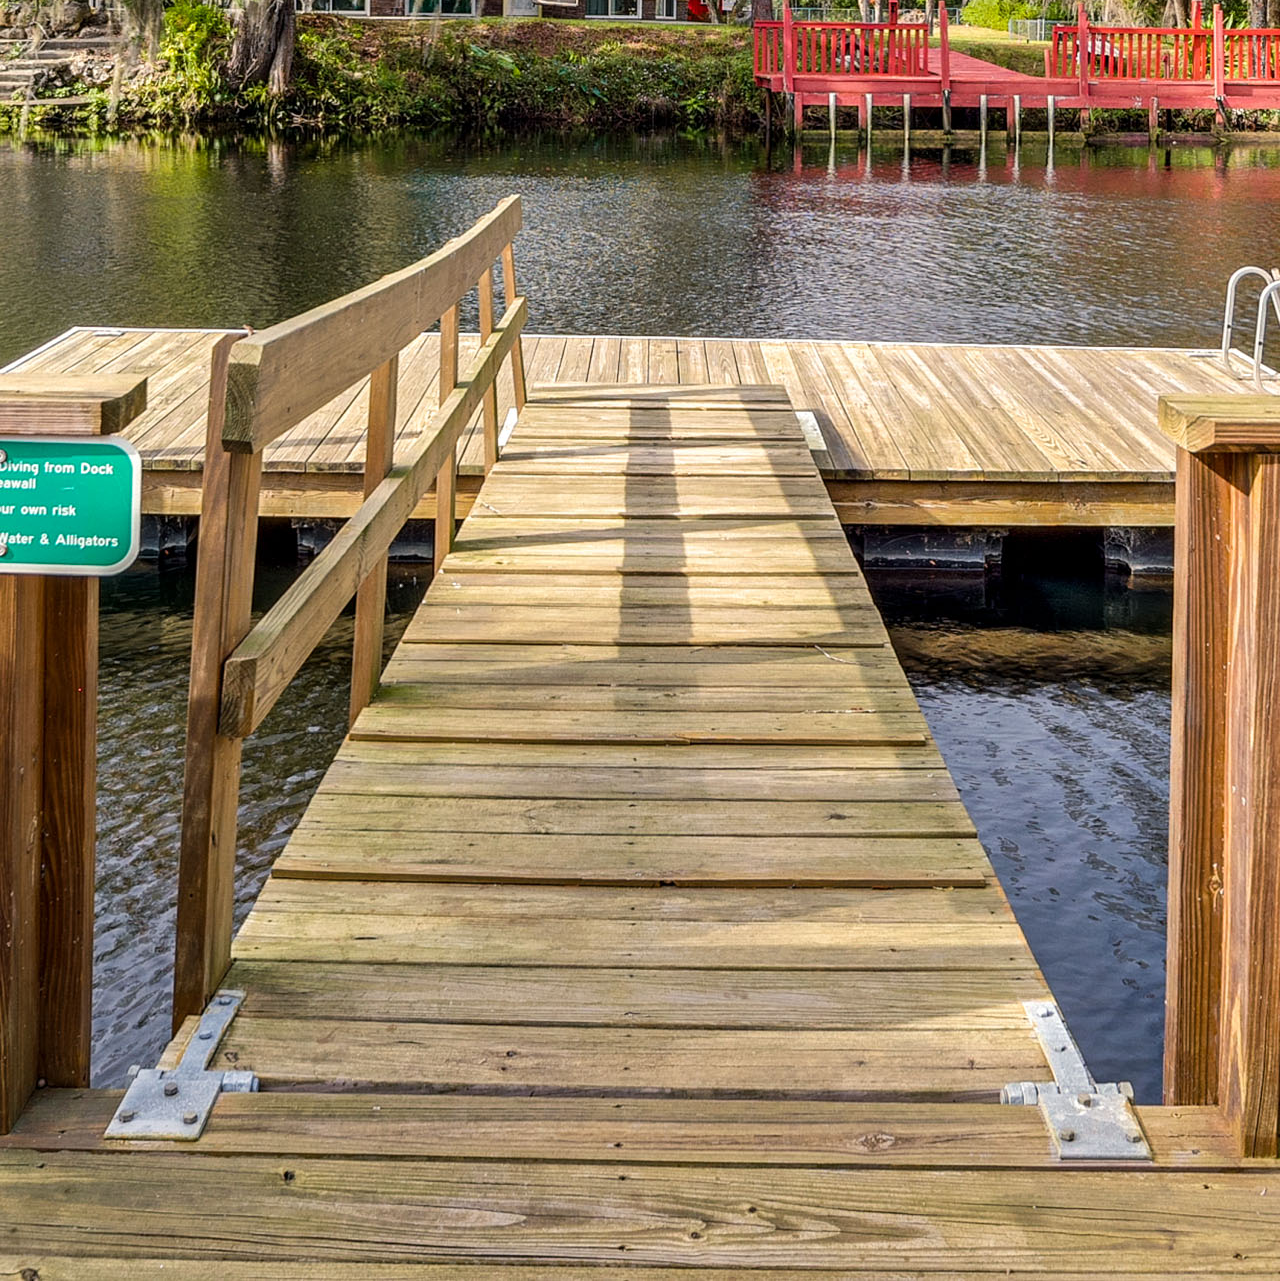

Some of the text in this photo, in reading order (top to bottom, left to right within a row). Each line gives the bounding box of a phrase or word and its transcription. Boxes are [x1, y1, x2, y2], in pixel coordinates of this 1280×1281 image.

[44, 461, 75, 473] from
[81, 461, 114, 475] Dock
[21, 506, 47, 515] own
[52, 505, 76, 516] risk
[40, 534, 49, 544] &
[56, 534, 118, 548] Alligators
